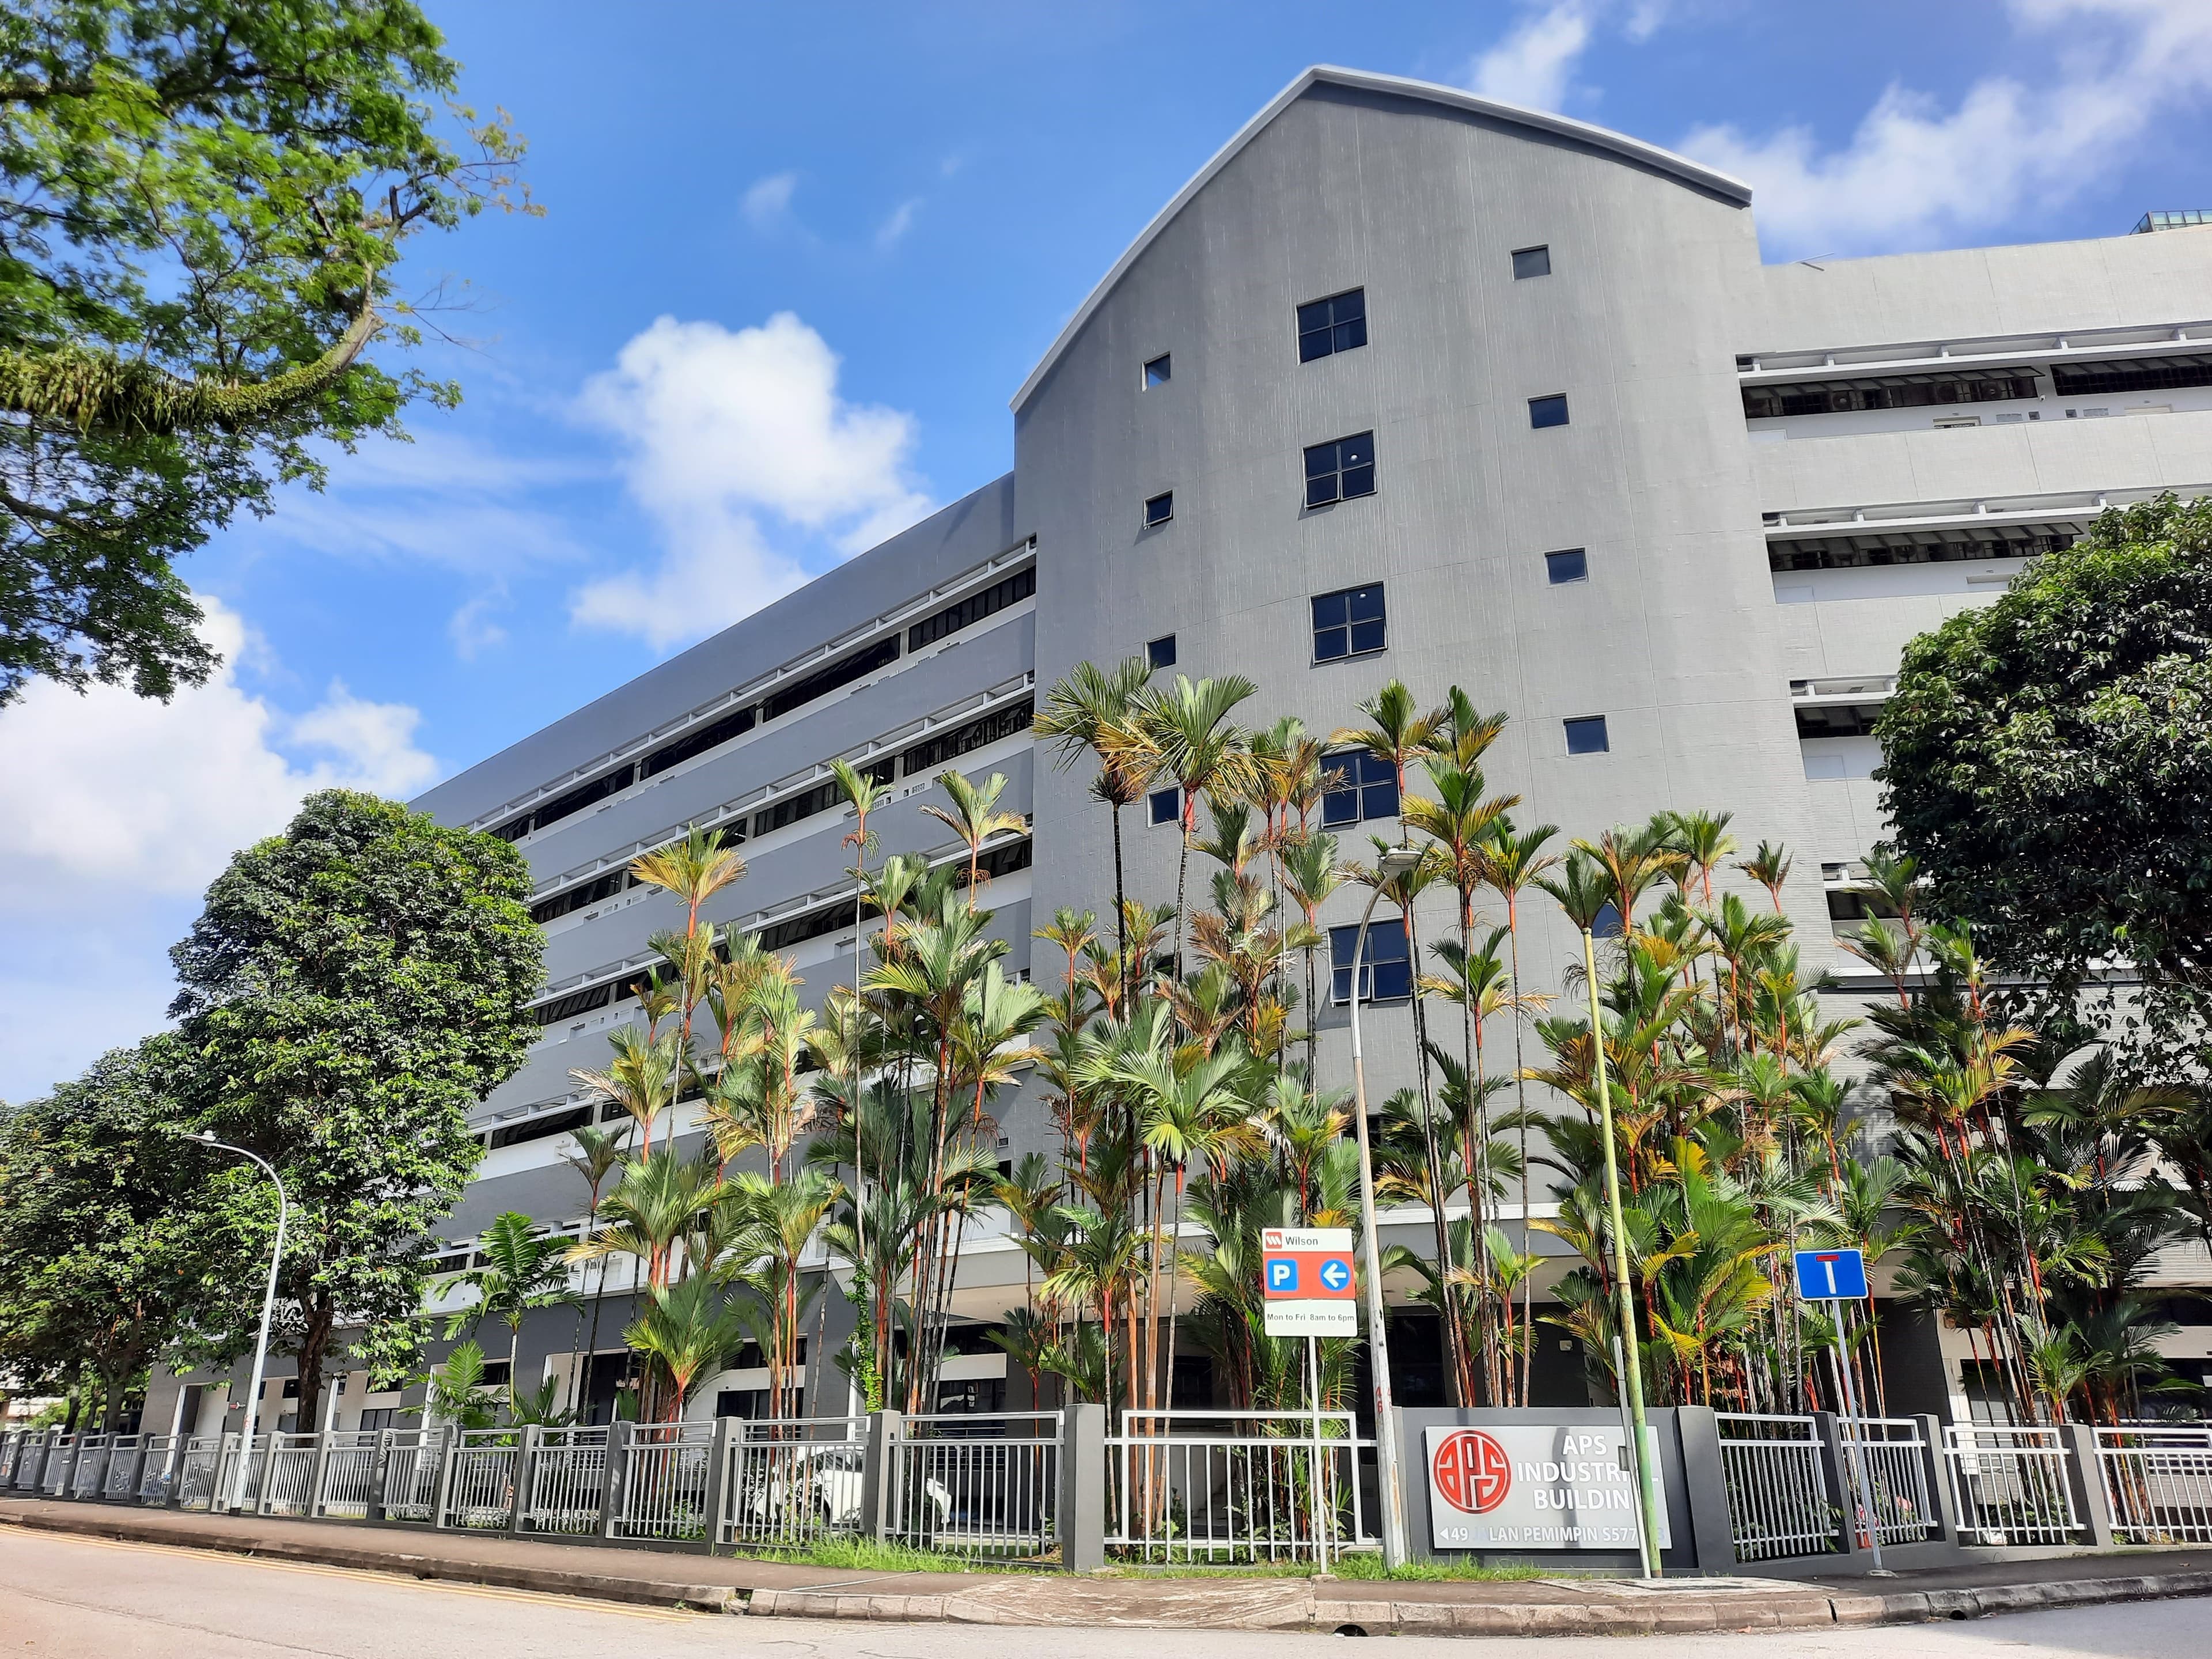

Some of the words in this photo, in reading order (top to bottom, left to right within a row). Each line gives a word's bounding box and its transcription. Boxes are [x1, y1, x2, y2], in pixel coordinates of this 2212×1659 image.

[1285, 1236, 1318, 1245] Wilson
[1273, 1264, 1290, 1286] P
[1338, 1315, 1354, 1323] 6pm
[1562, 1434, 1607, 1456] APS
[1533, 1488, 1636, 1510] BUILDIN
[1451, 1527, 1468, 1541] 49
[1524, 1527, 1599, 1542] PEMIMPIN
